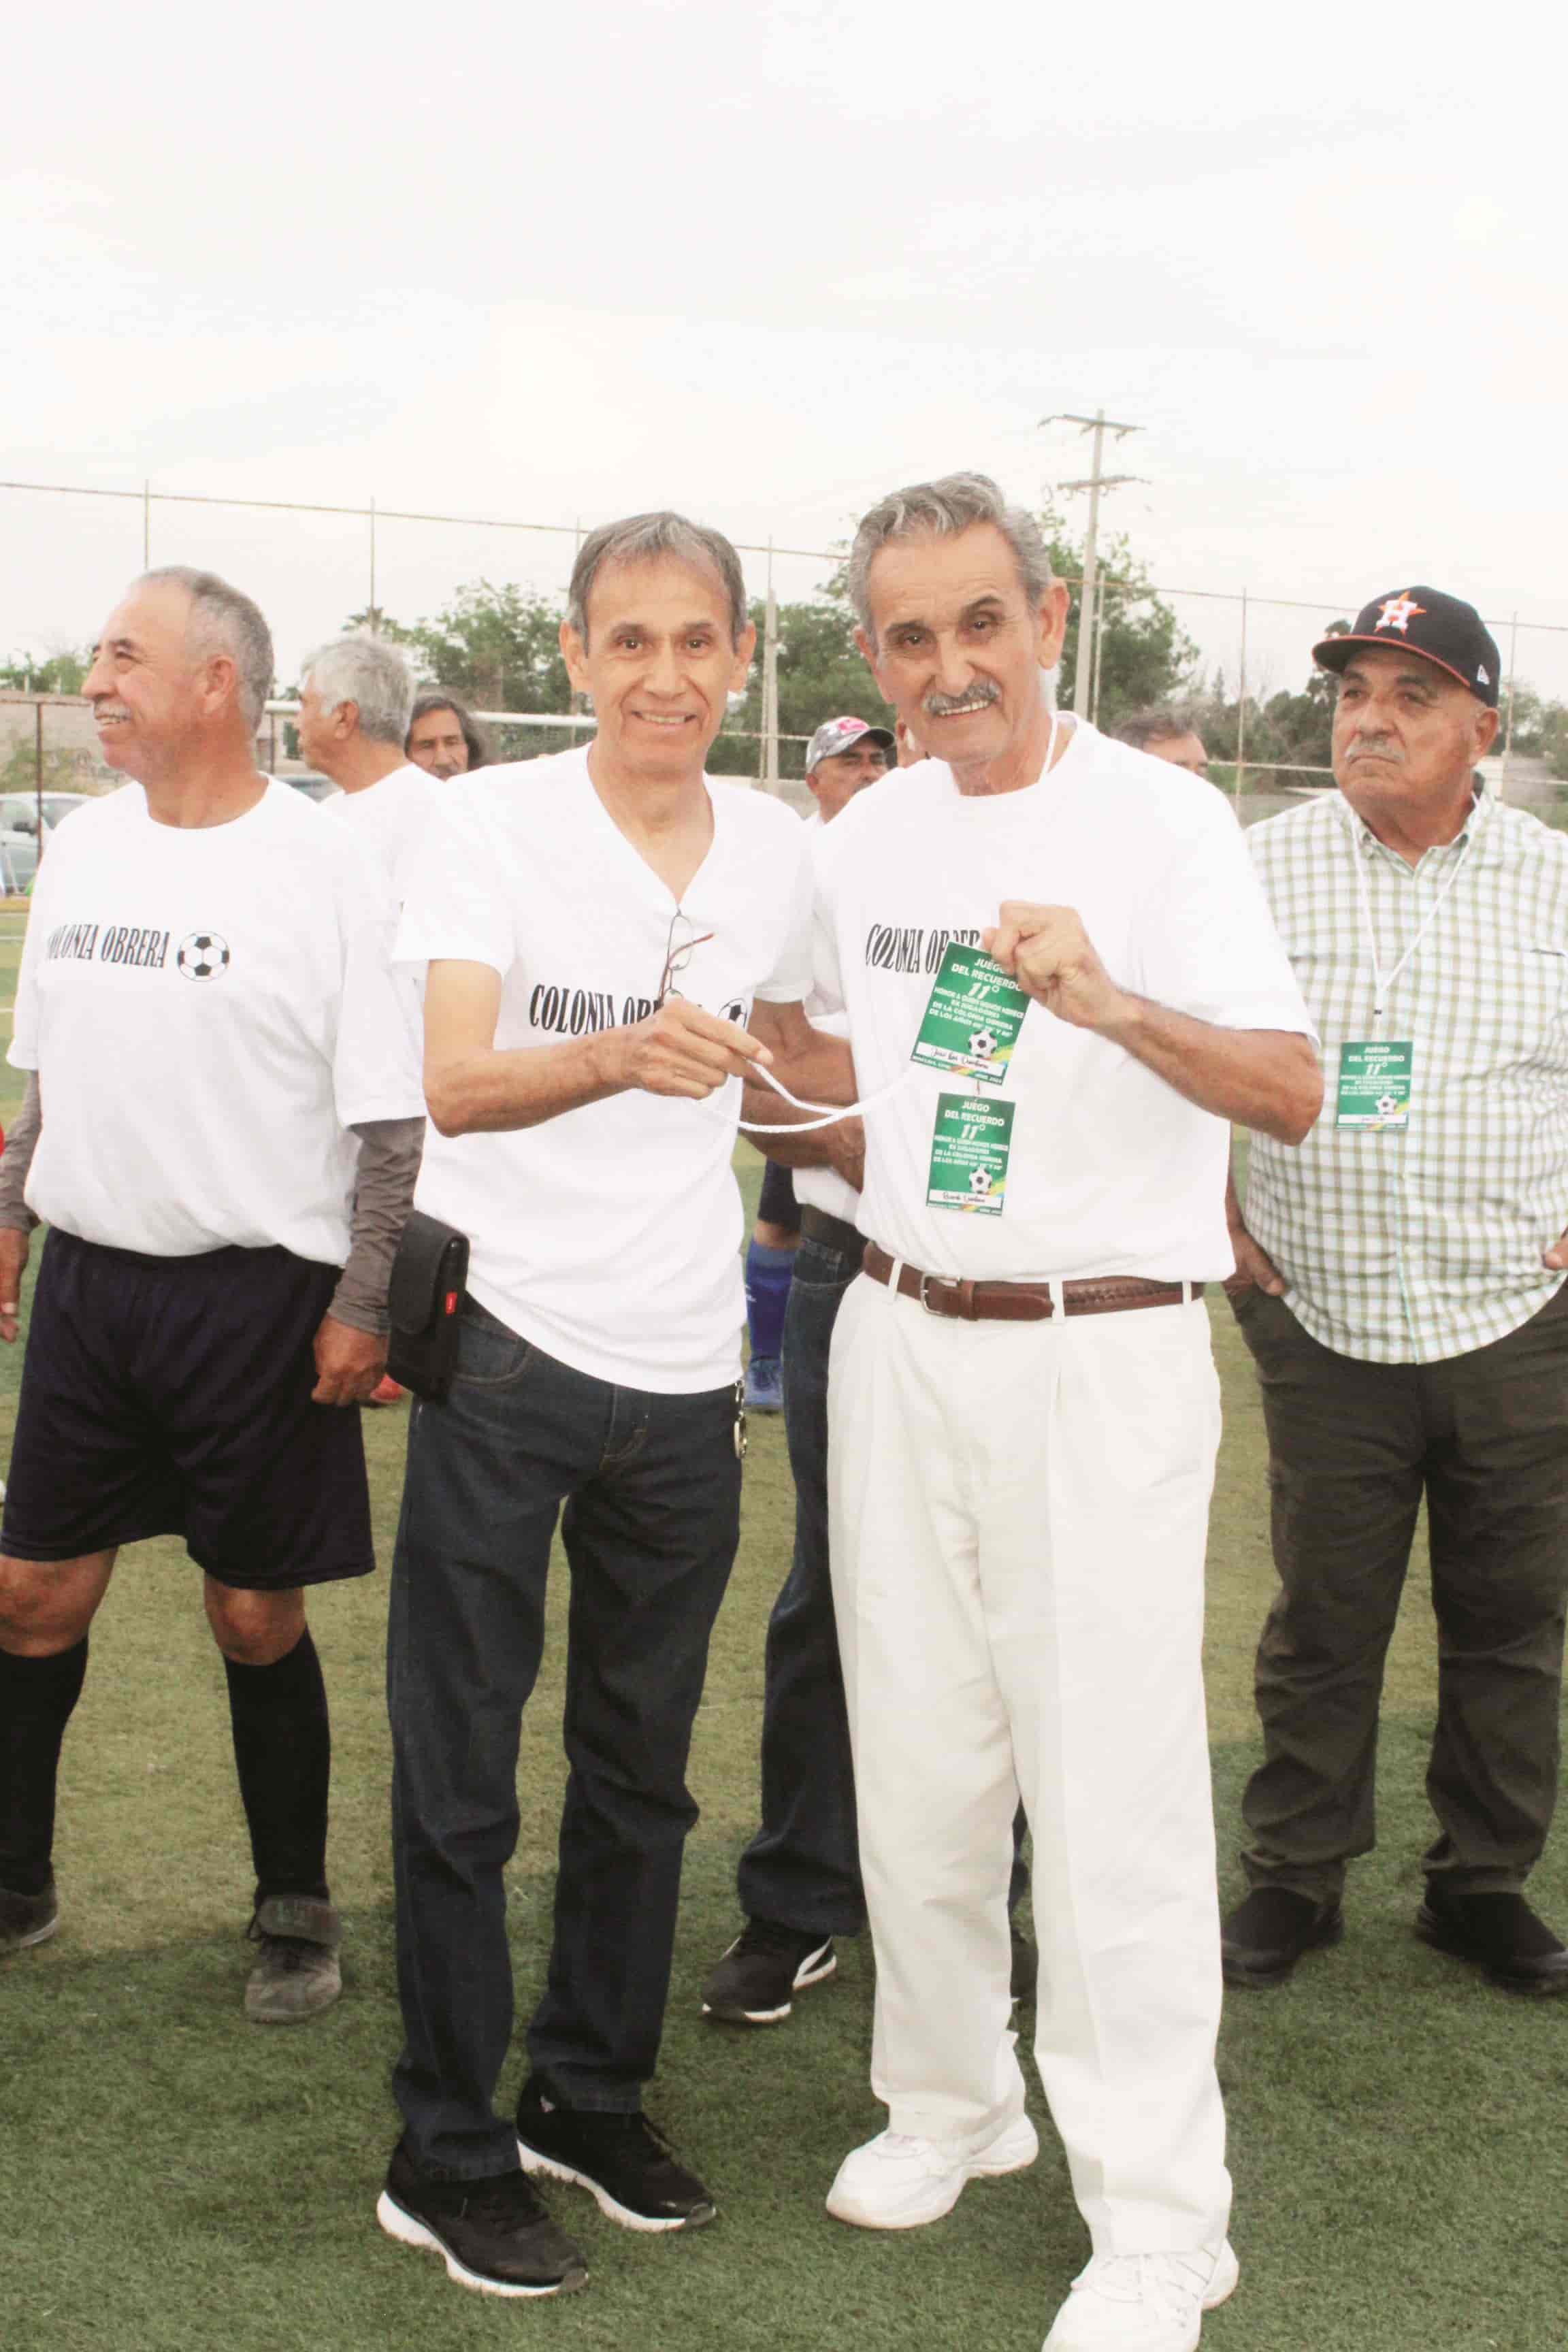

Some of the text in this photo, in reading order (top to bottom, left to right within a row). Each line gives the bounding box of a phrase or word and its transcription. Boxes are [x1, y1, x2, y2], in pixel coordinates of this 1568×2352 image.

[101, 926, 169, 968] OBRERA
[951, 963, 970, 976] DEL
[975, 958, 1004, 974] JUEG
[529, 984, 615, 1035] COLONIA
[962, 1101, 990, 1113] JUEGO
[944, 1109, 960, 1120] DEL
